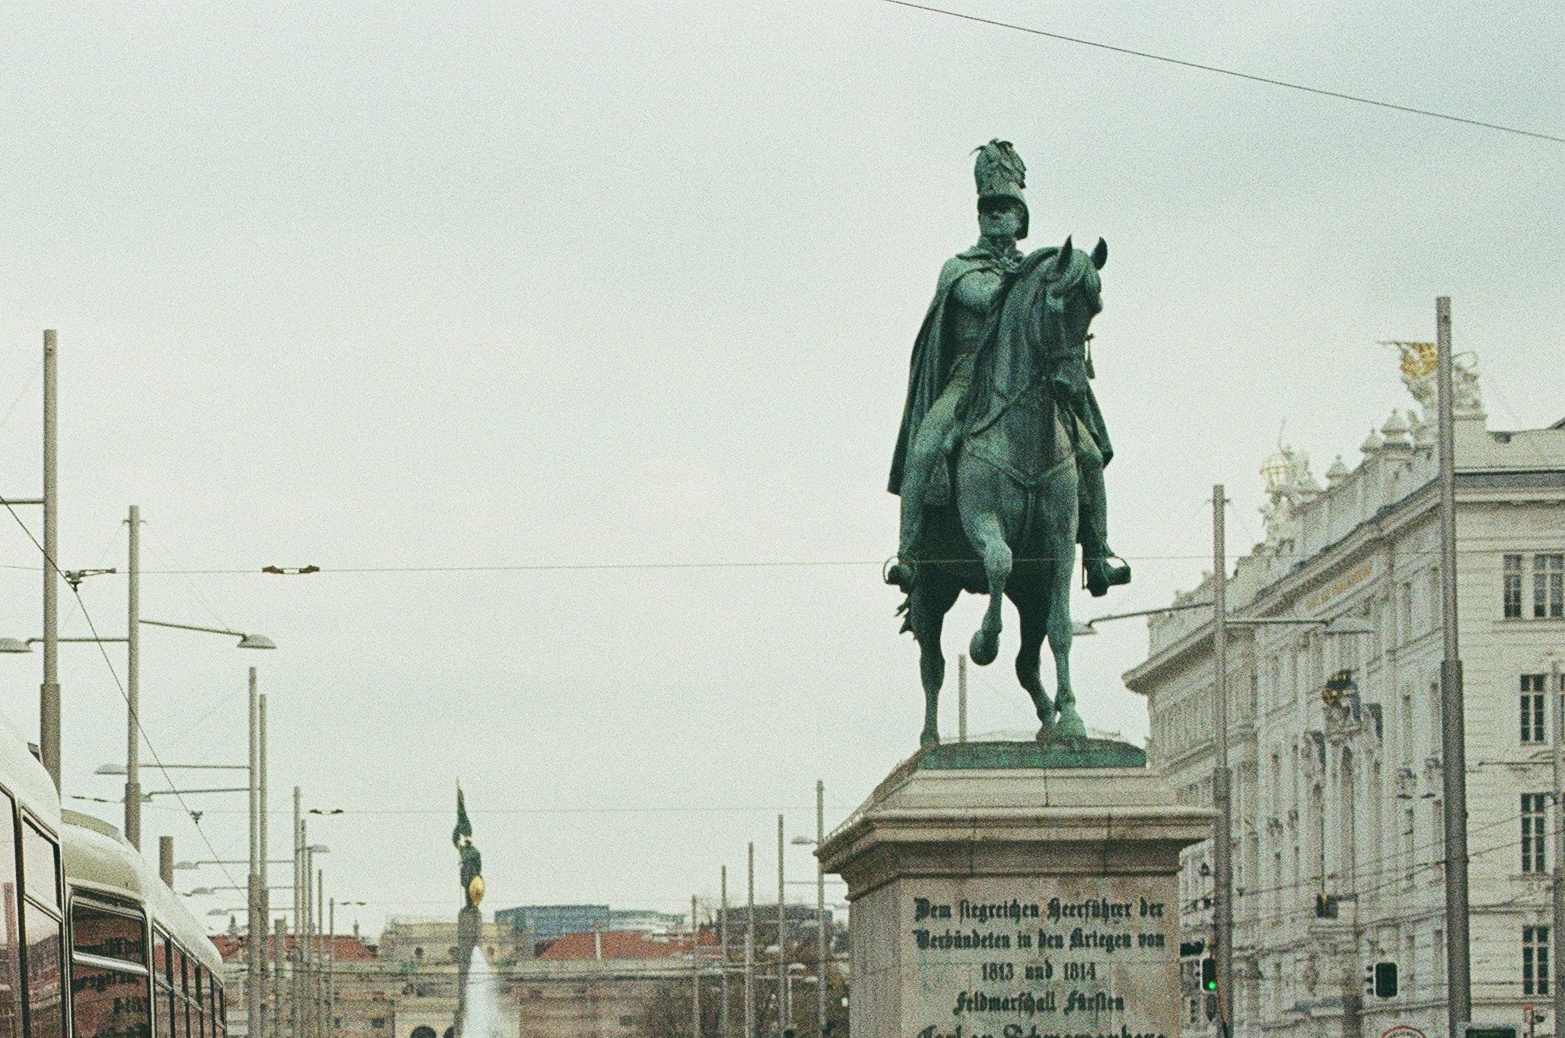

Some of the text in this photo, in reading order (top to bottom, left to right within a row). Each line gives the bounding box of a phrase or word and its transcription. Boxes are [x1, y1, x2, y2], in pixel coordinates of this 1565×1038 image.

[914, 897, 951, 922] Dem
[1140, 897, 1164, 918] der
[1018, 930, 1032, 949] in
[1039, 928, 1064, 951] den
[1070, 927, 1131, 953] Kriegen
[1138, 932, 1165, 948] von
[982, 959, 1097, 981] 1813 und 1814
